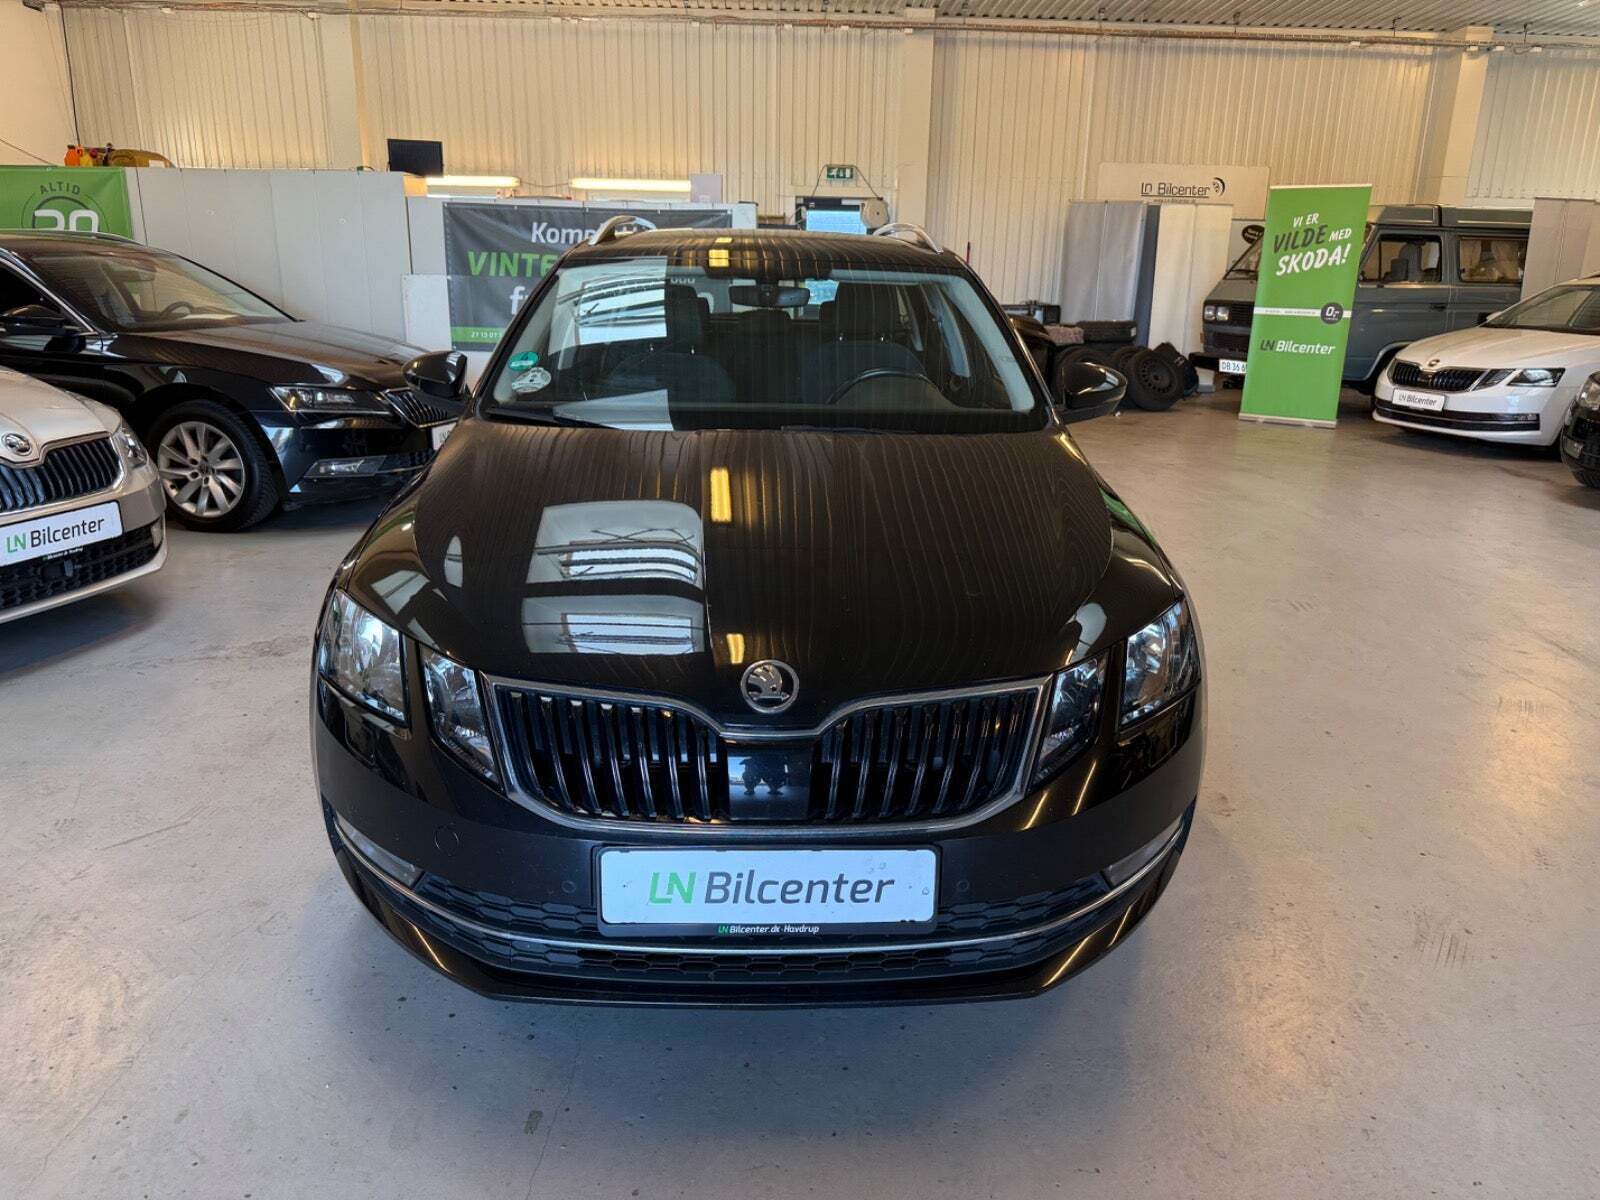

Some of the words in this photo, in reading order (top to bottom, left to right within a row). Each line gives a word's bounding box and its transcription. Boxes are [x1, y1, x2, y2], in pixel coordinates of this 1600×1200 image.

[40, 181, 80, 195] ALTID
[1158, 182, 1210, 196] Bilcenter
[1293, 215, 1304, 228] VI
[1306, 213, 1320, 225] ER
[1273, 224, 1329, 254] VILDE
[1328, 227, 1352, 242] MED
[1276, 243, 1352, 276] SKODA!
[1275, 340, 1336, 355] Bilcenter
[1407, 394, 1437, 406] Bilcenter
[6, 532, 27, 553] LN
[30, 518, 105, 548] Bilcenter
[649, 871, 697, 904] LN
[704, 869, 896, 904] Bilcenter
[783, 924, 820, 934] Havdrup
